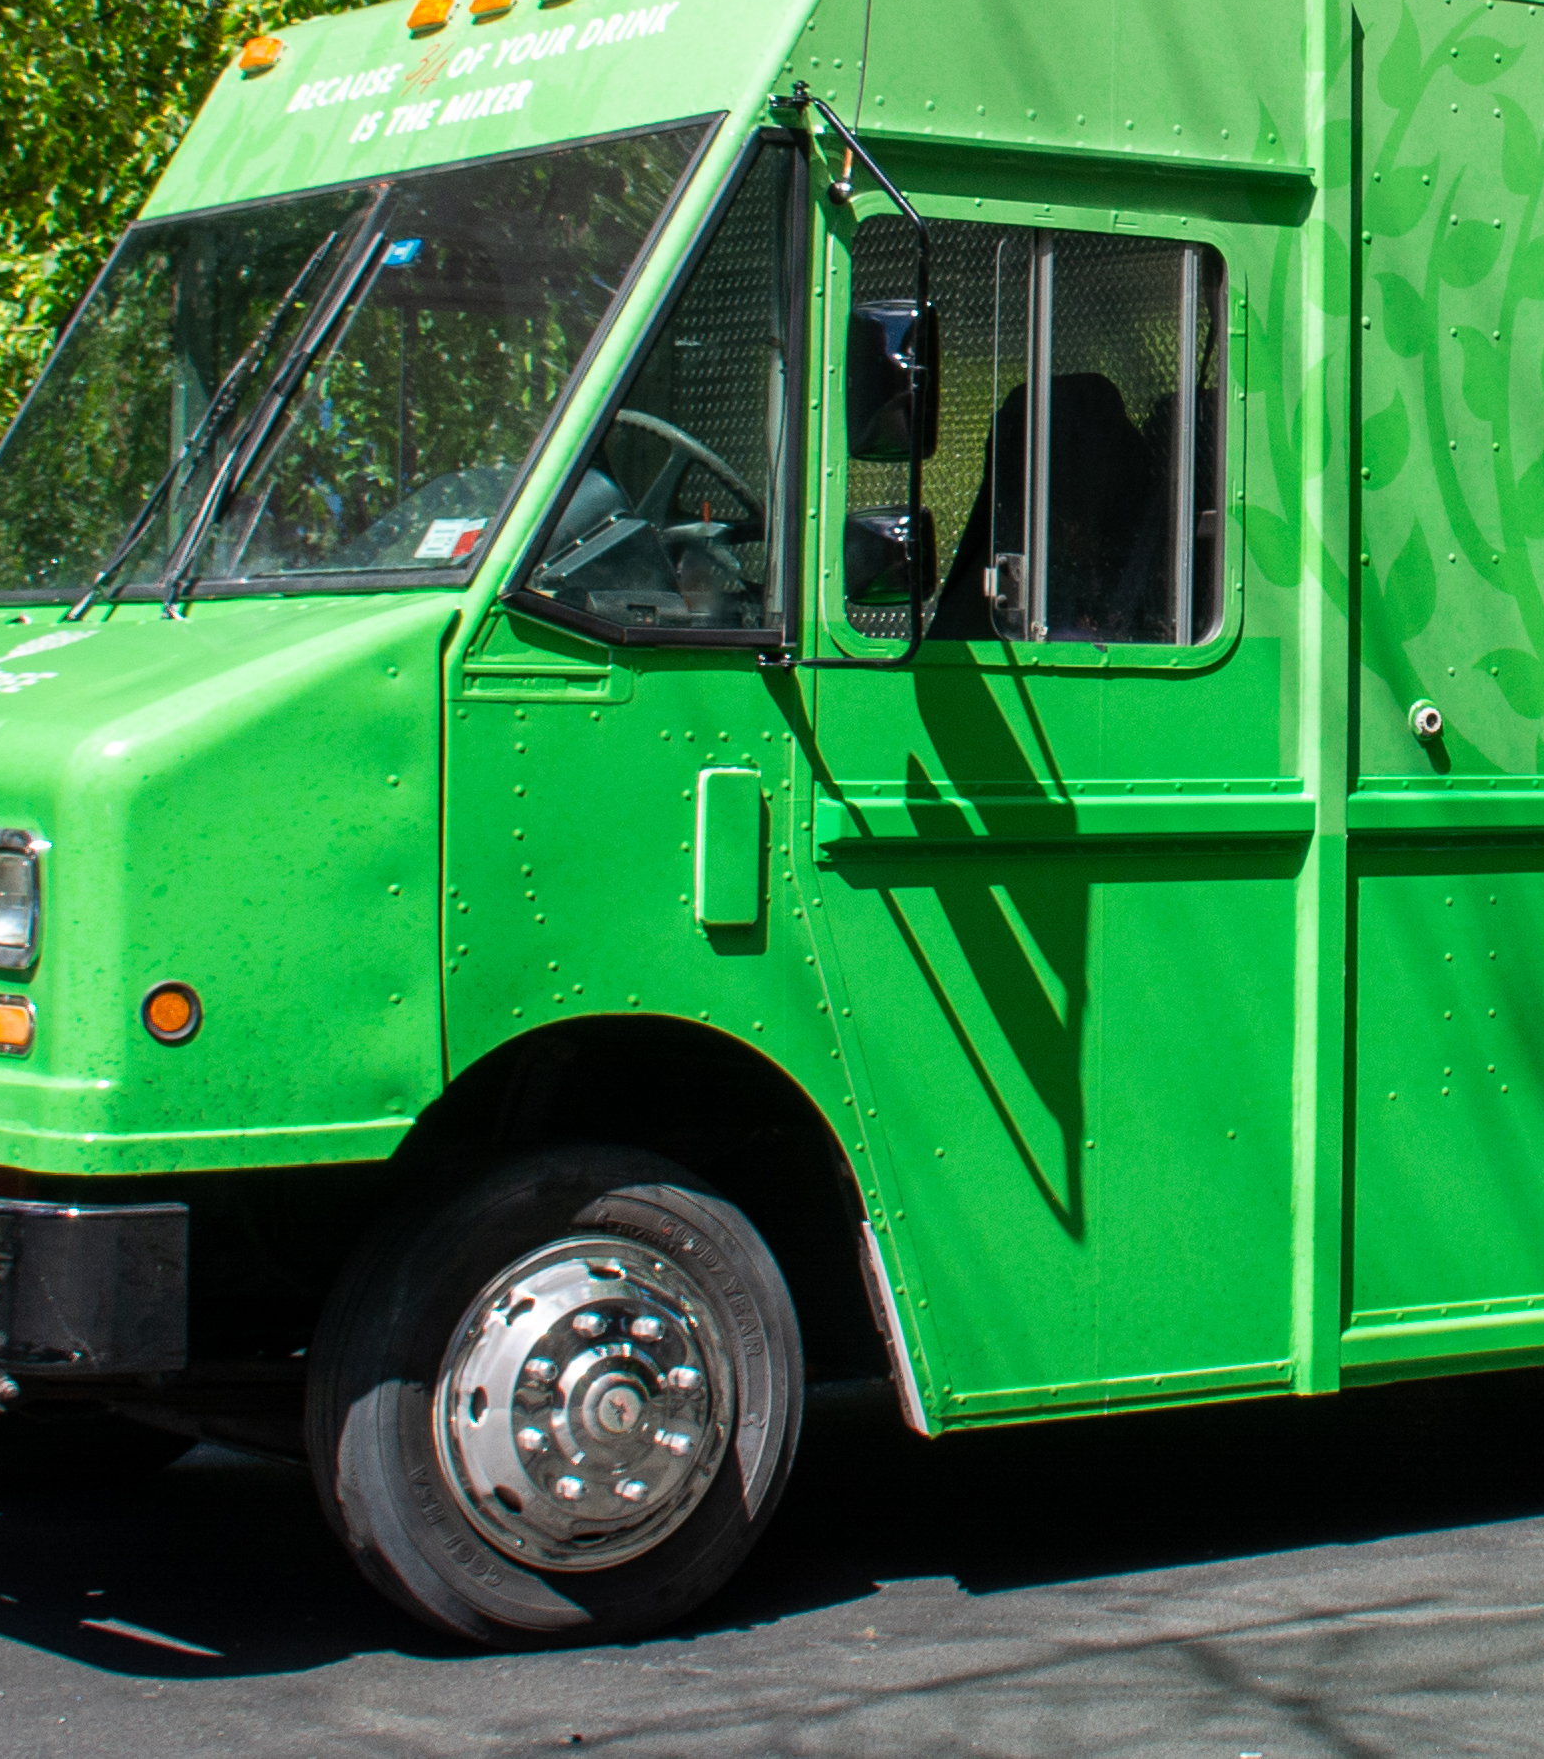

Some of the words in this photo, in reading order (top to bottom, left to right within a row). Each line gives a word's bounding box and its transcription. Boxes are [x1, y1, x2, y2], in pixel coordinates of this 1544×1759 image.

[286, 63, 404, 114] BECAUSE
[446, 42, 493, 80] OF
[492, 24, 576, 69] YOUR
[576, 0, 680, 51] DRINK
[349, 111, 383, 144] IS
[383, 98, 442, 137] THE
[437, 79, 534, 126] MIXER
